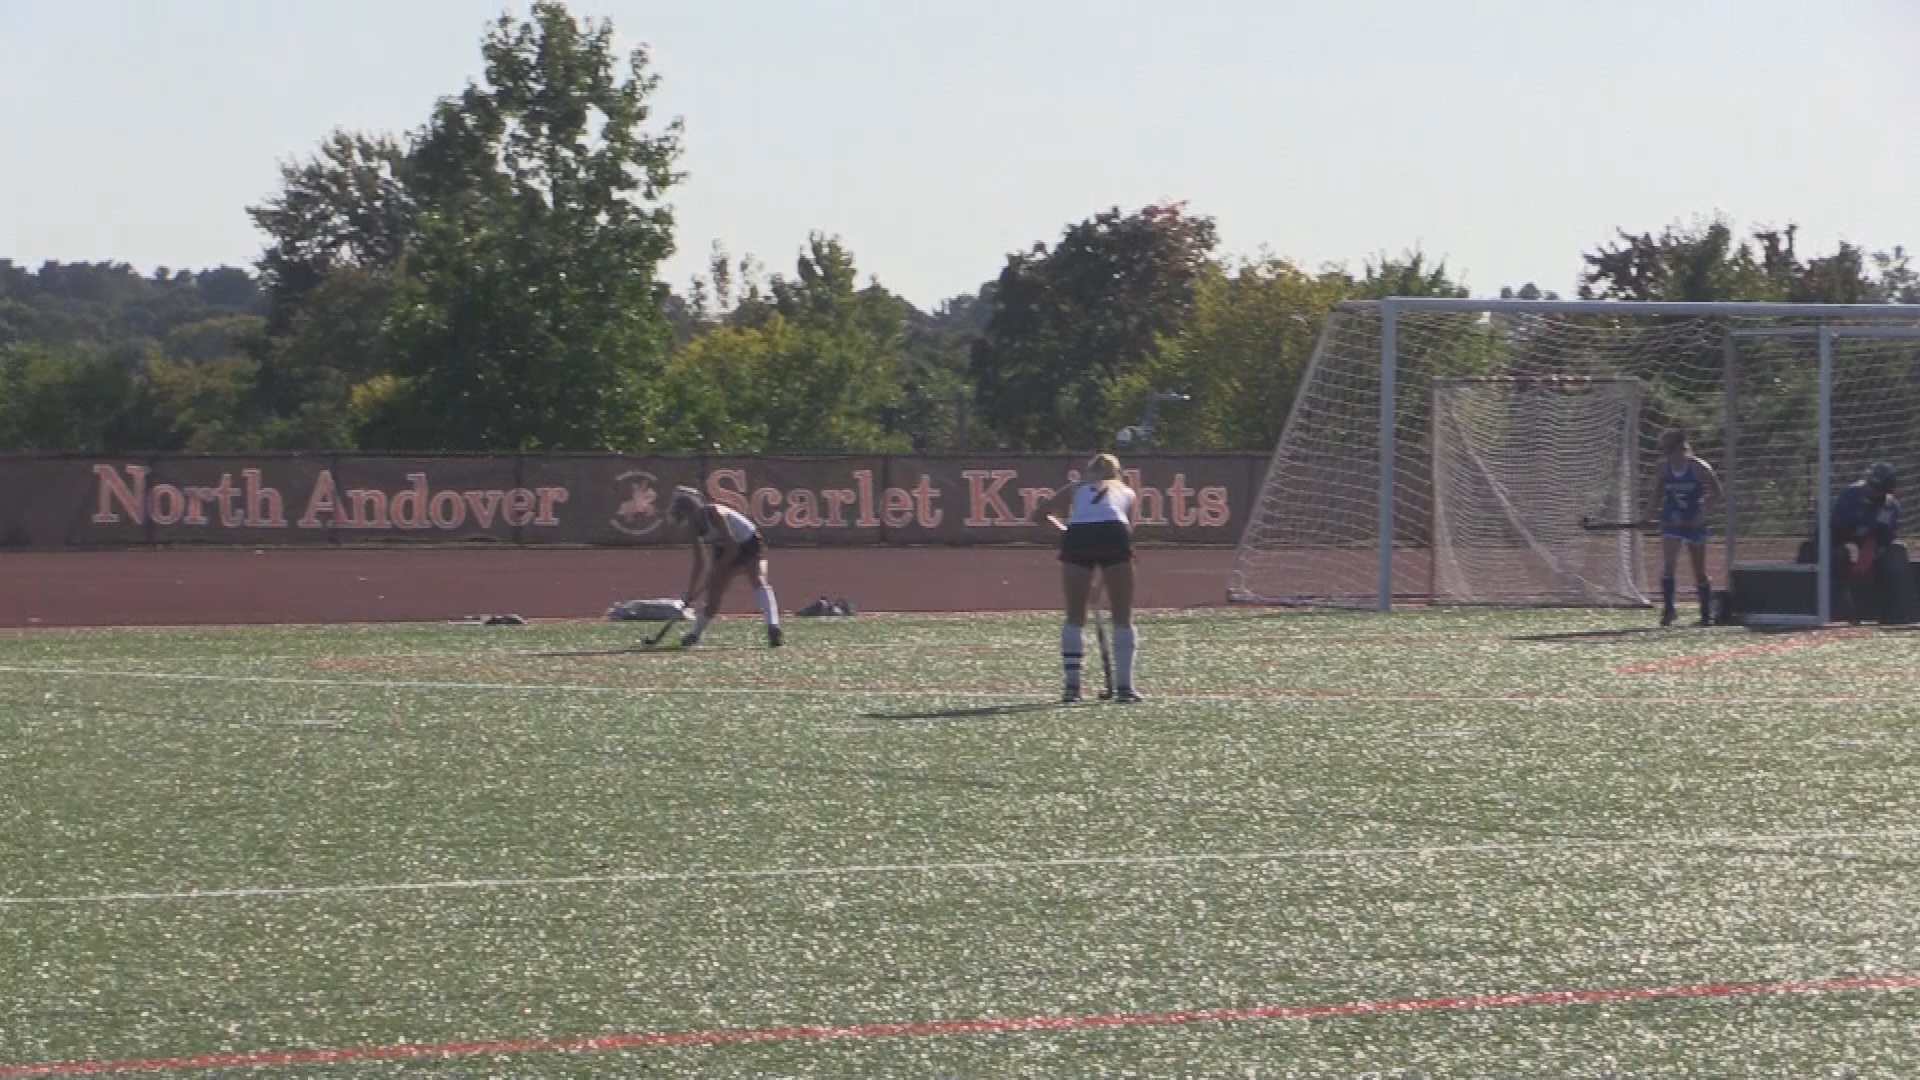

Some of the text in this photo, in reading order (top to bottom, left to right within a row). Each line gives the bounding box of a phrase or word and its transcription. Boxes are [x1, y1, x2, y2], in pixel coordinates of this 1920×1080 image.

[93, 464, 1231, 530] North Andover Scarlet Knhts
